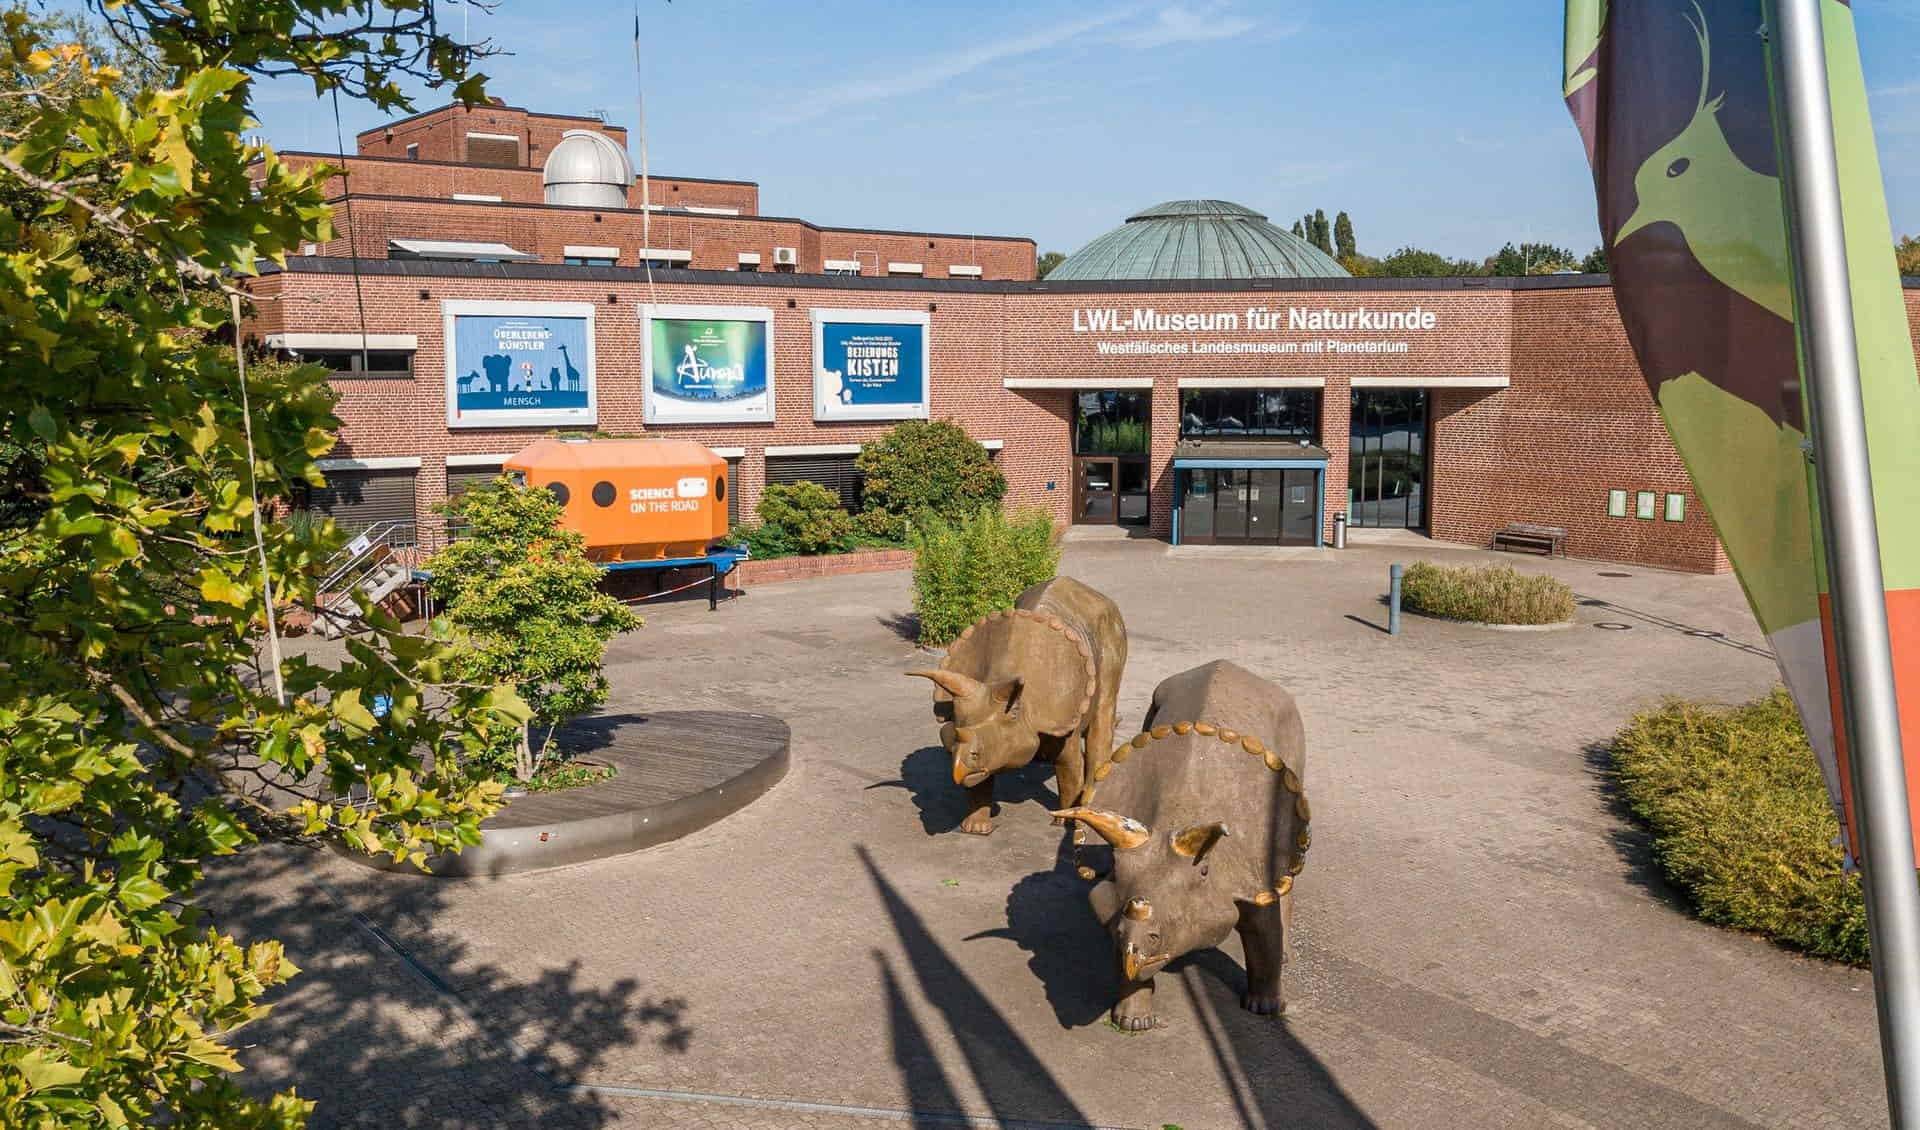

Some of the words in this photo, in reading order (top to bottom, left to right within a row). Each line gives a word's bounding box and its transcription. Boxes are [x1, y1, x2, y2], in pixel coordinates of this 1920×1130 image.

[1072, 308, 1239, 332] LWL-Museum
[1246, 307, 1280, 330] für
[1288, 307, 1437, 330] Naturkunde
[847, 347, 899, 358] BEZIEHUNGS
[1097, 341, 1189, 354] Westfälisches
[1192, 340, 1298, 353] Landesmuseum
[1302, 341, 1323, 353] mit
[1327, 340, 1409, 353] Planetarium
[847, 359, 899, 376] KISTEN
[503, 397, 541, 406] MENSCH
[630, 488, 674, 499] SCIENCE
[631, 503, 646, 512] ON
[649, 502, 669, 512] THE
[671, 500, 699, 511] ROAD
